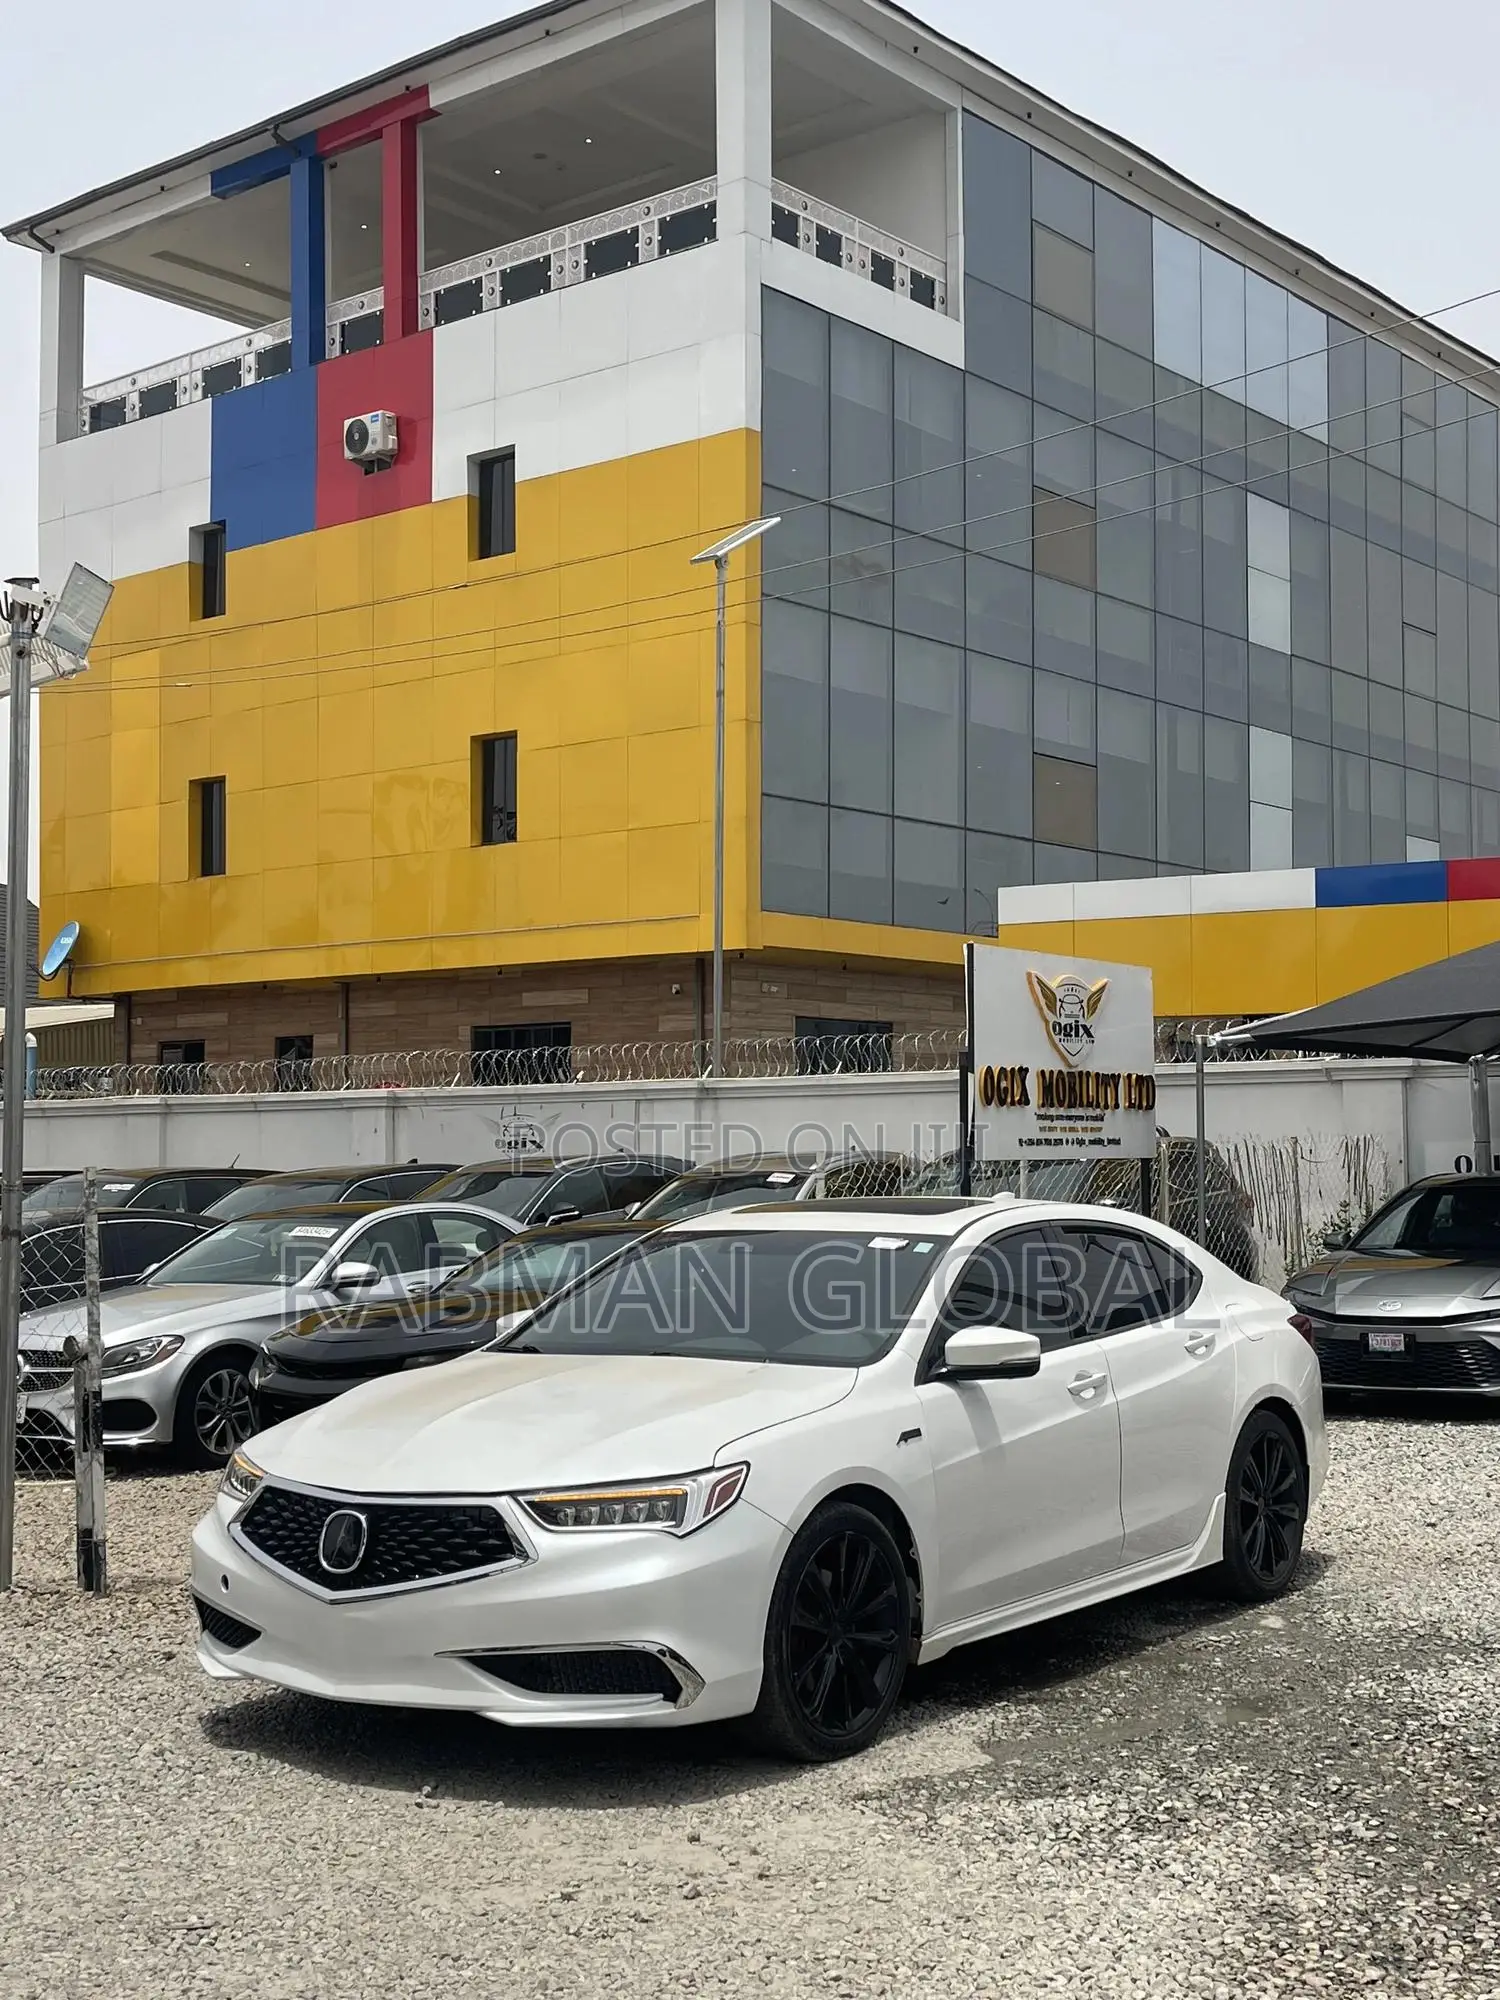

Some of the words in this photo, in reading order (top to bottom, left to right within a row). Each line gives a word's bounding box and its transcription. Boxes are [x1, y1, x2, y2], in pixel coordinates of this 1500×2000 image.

[979, 1064, 1031, 1108] OGIX
[1036, 1068, 1122, 1111] MOBILITY
[1123, 1072, 1157, 1112] LTD
